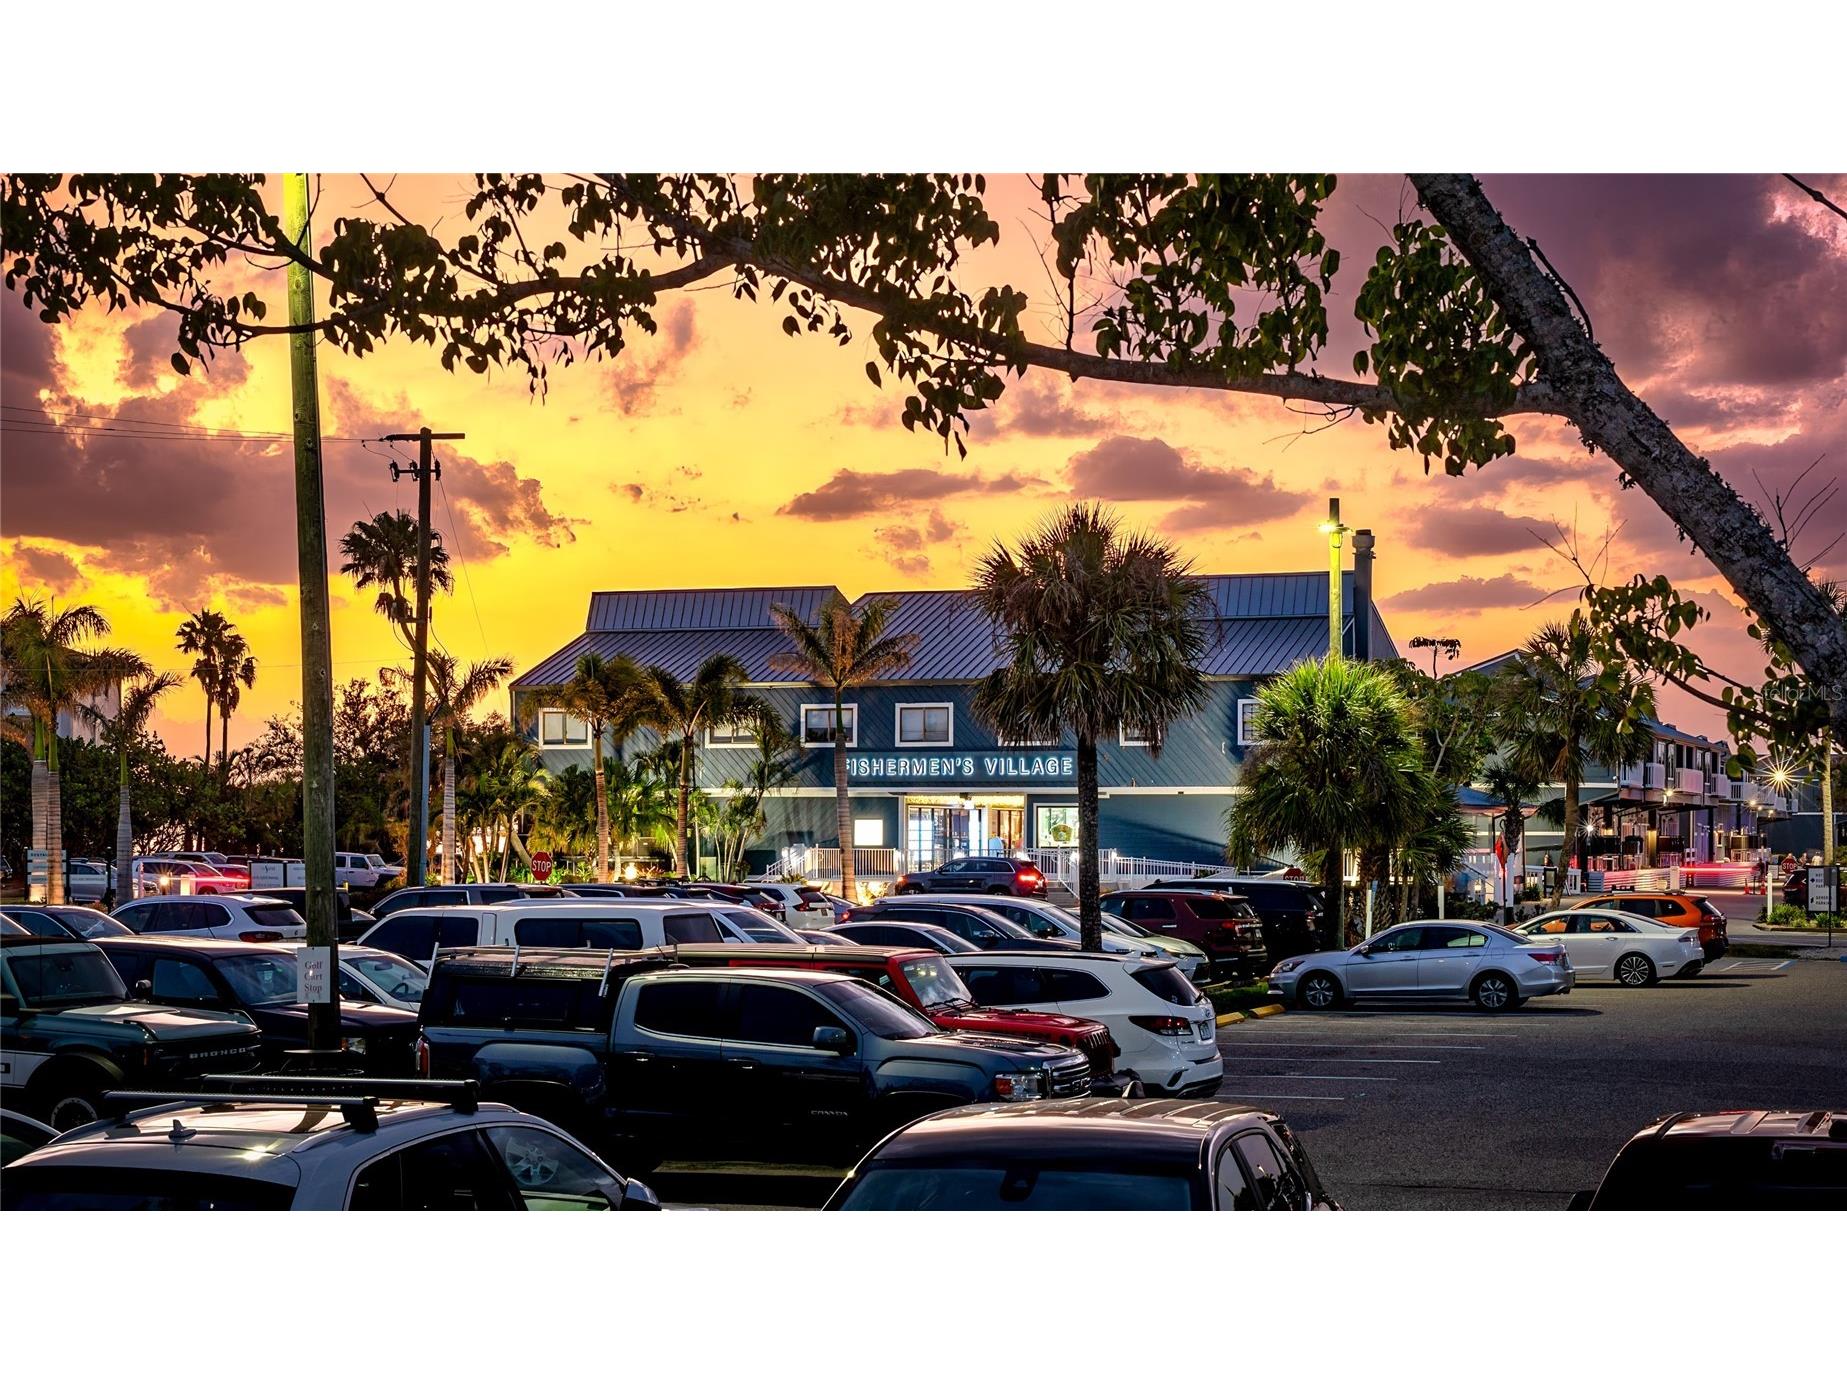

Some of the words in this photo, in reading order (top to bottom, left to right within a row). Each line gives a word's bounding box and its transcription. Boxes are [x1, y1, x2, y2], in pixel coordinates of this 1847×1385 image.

[984, 757, 1073, 775] VILLAGE
[532, 860, 552, 872] STOP
[304, 960, 322, 970] Golf
[304, 983, 322, 994] Stop
[188, 1047, 246, 1059] BRONCO
